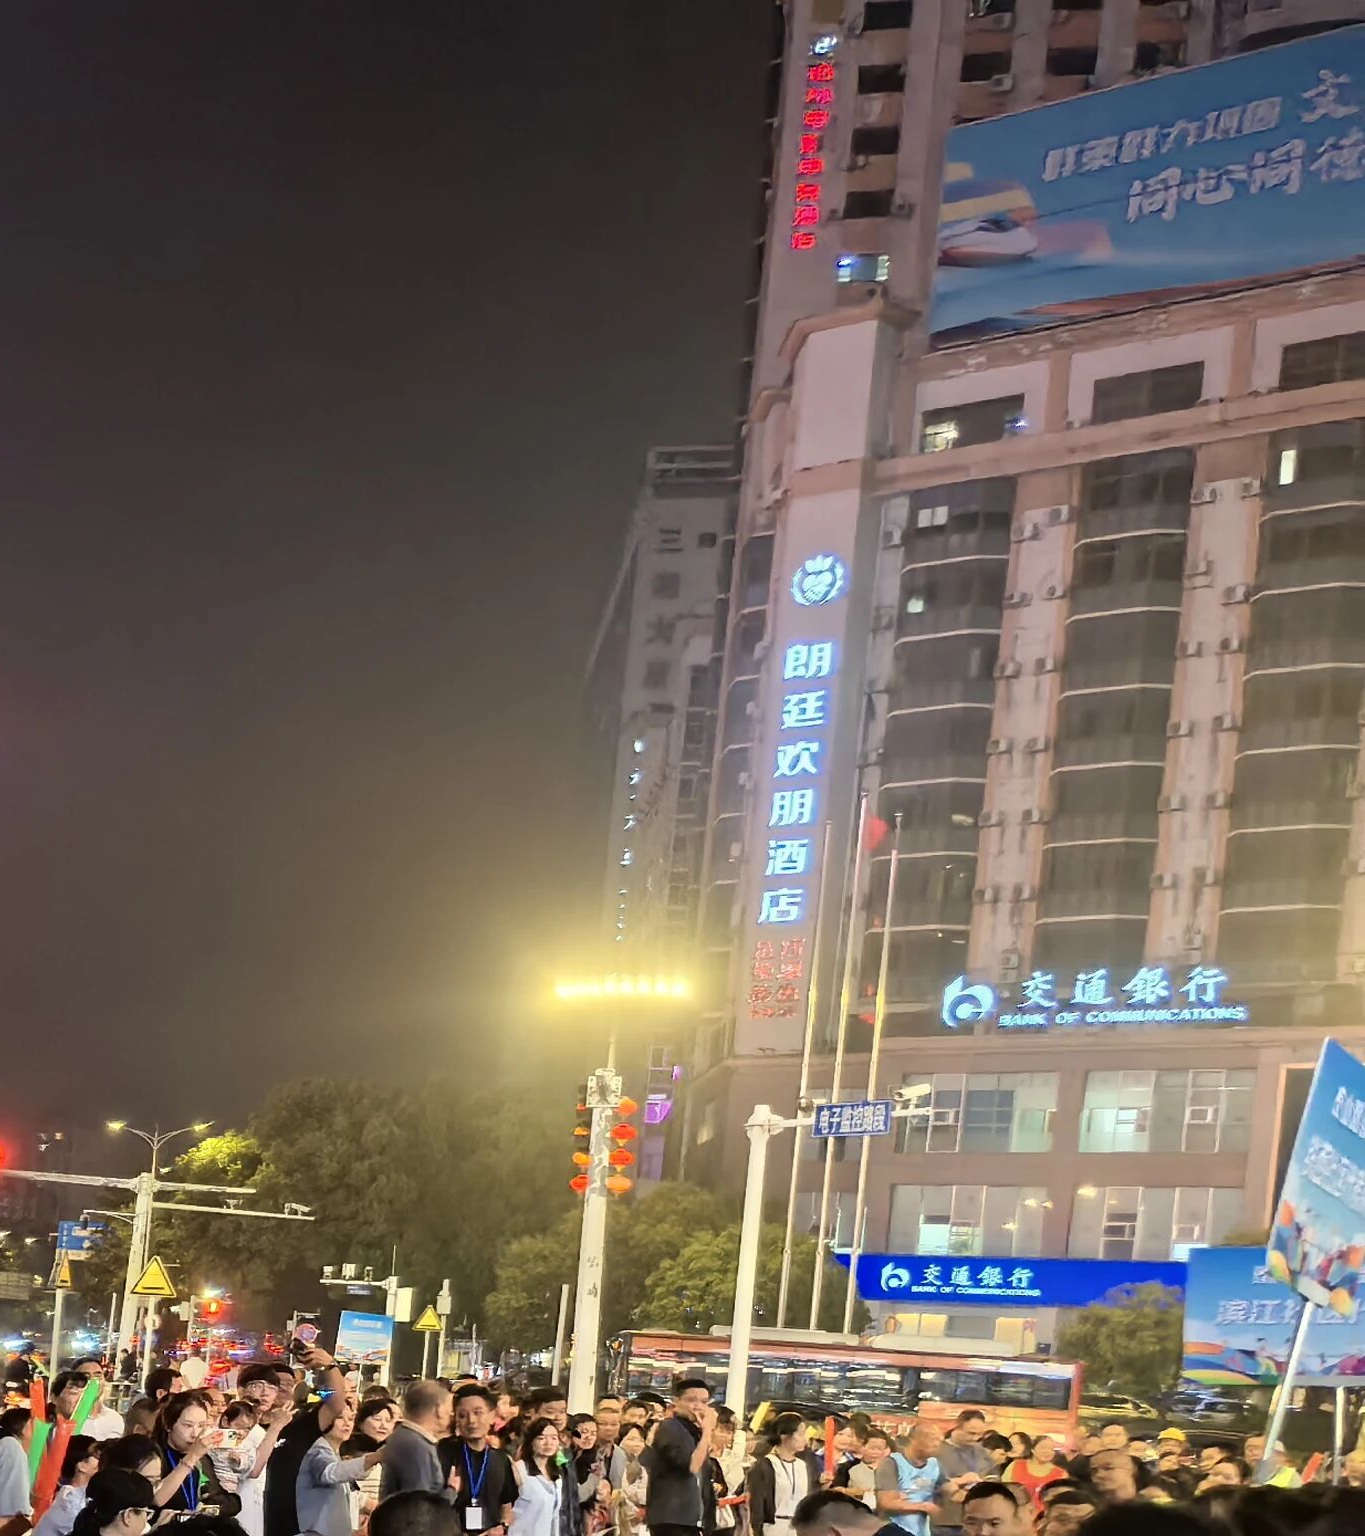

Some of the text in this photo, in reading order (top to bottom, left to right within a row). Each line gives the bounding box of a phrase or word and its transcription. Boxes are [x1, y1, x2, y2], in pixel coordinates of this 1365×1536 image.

[1299, 68, 1360, 124] 文
[758, 642, 833, 926] 朗廷欢朋酒店
[998, 1006, 1246, 1027] BANK OF COMMUNICATIONS
[819, 1104, 886, 1133] 电子监控路段
[911, 1285, 1041, 1297] BANK OF COMMUNICATIONS
